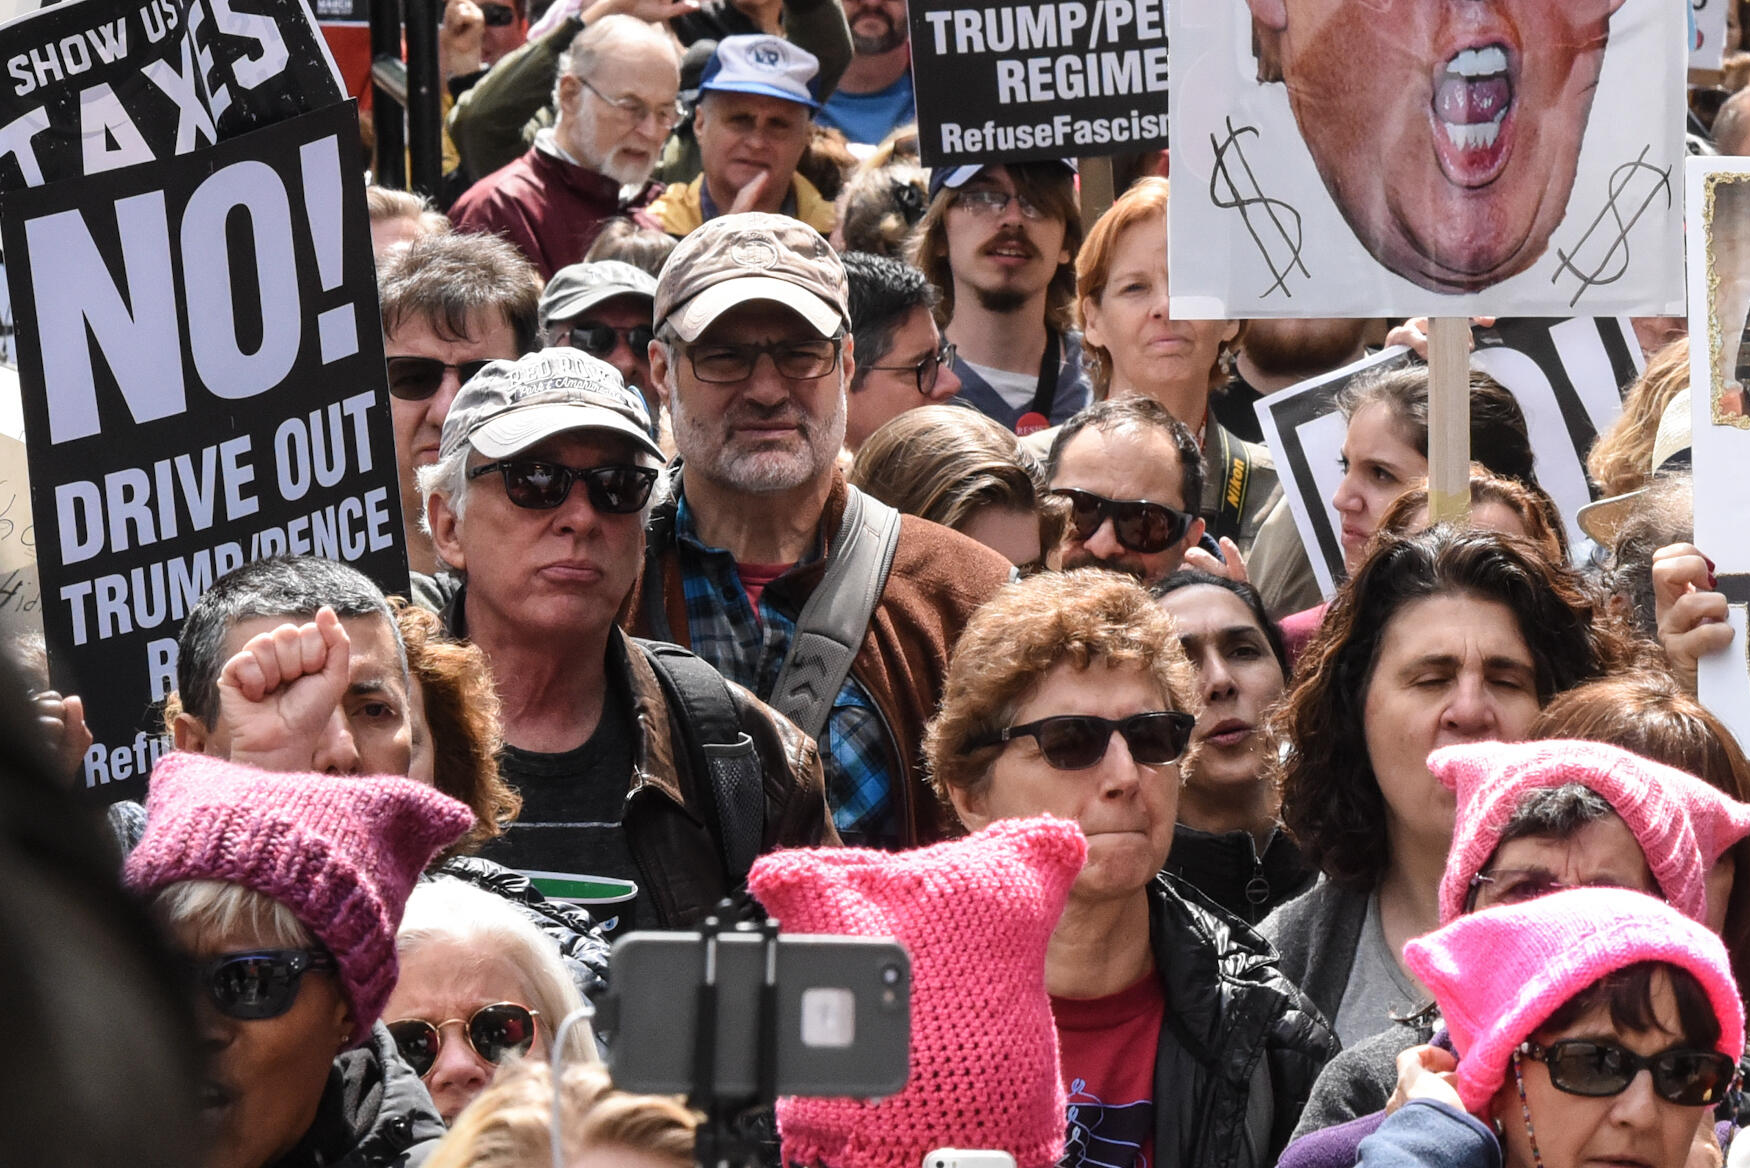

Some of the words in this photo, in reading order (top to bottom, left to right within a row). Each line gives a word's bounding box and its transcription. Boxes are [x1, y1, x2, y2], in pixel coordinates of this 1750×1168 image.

[7, 18, 129, 97] SHOW
[996, 51, 1170, 105] REGIME
[24, 134, 359, 446] NO!
[54, 434, 260, 566] DRIVE
[275, 389, 377, 504] OUT
[1226, 457, 1246, 509] Nikon
